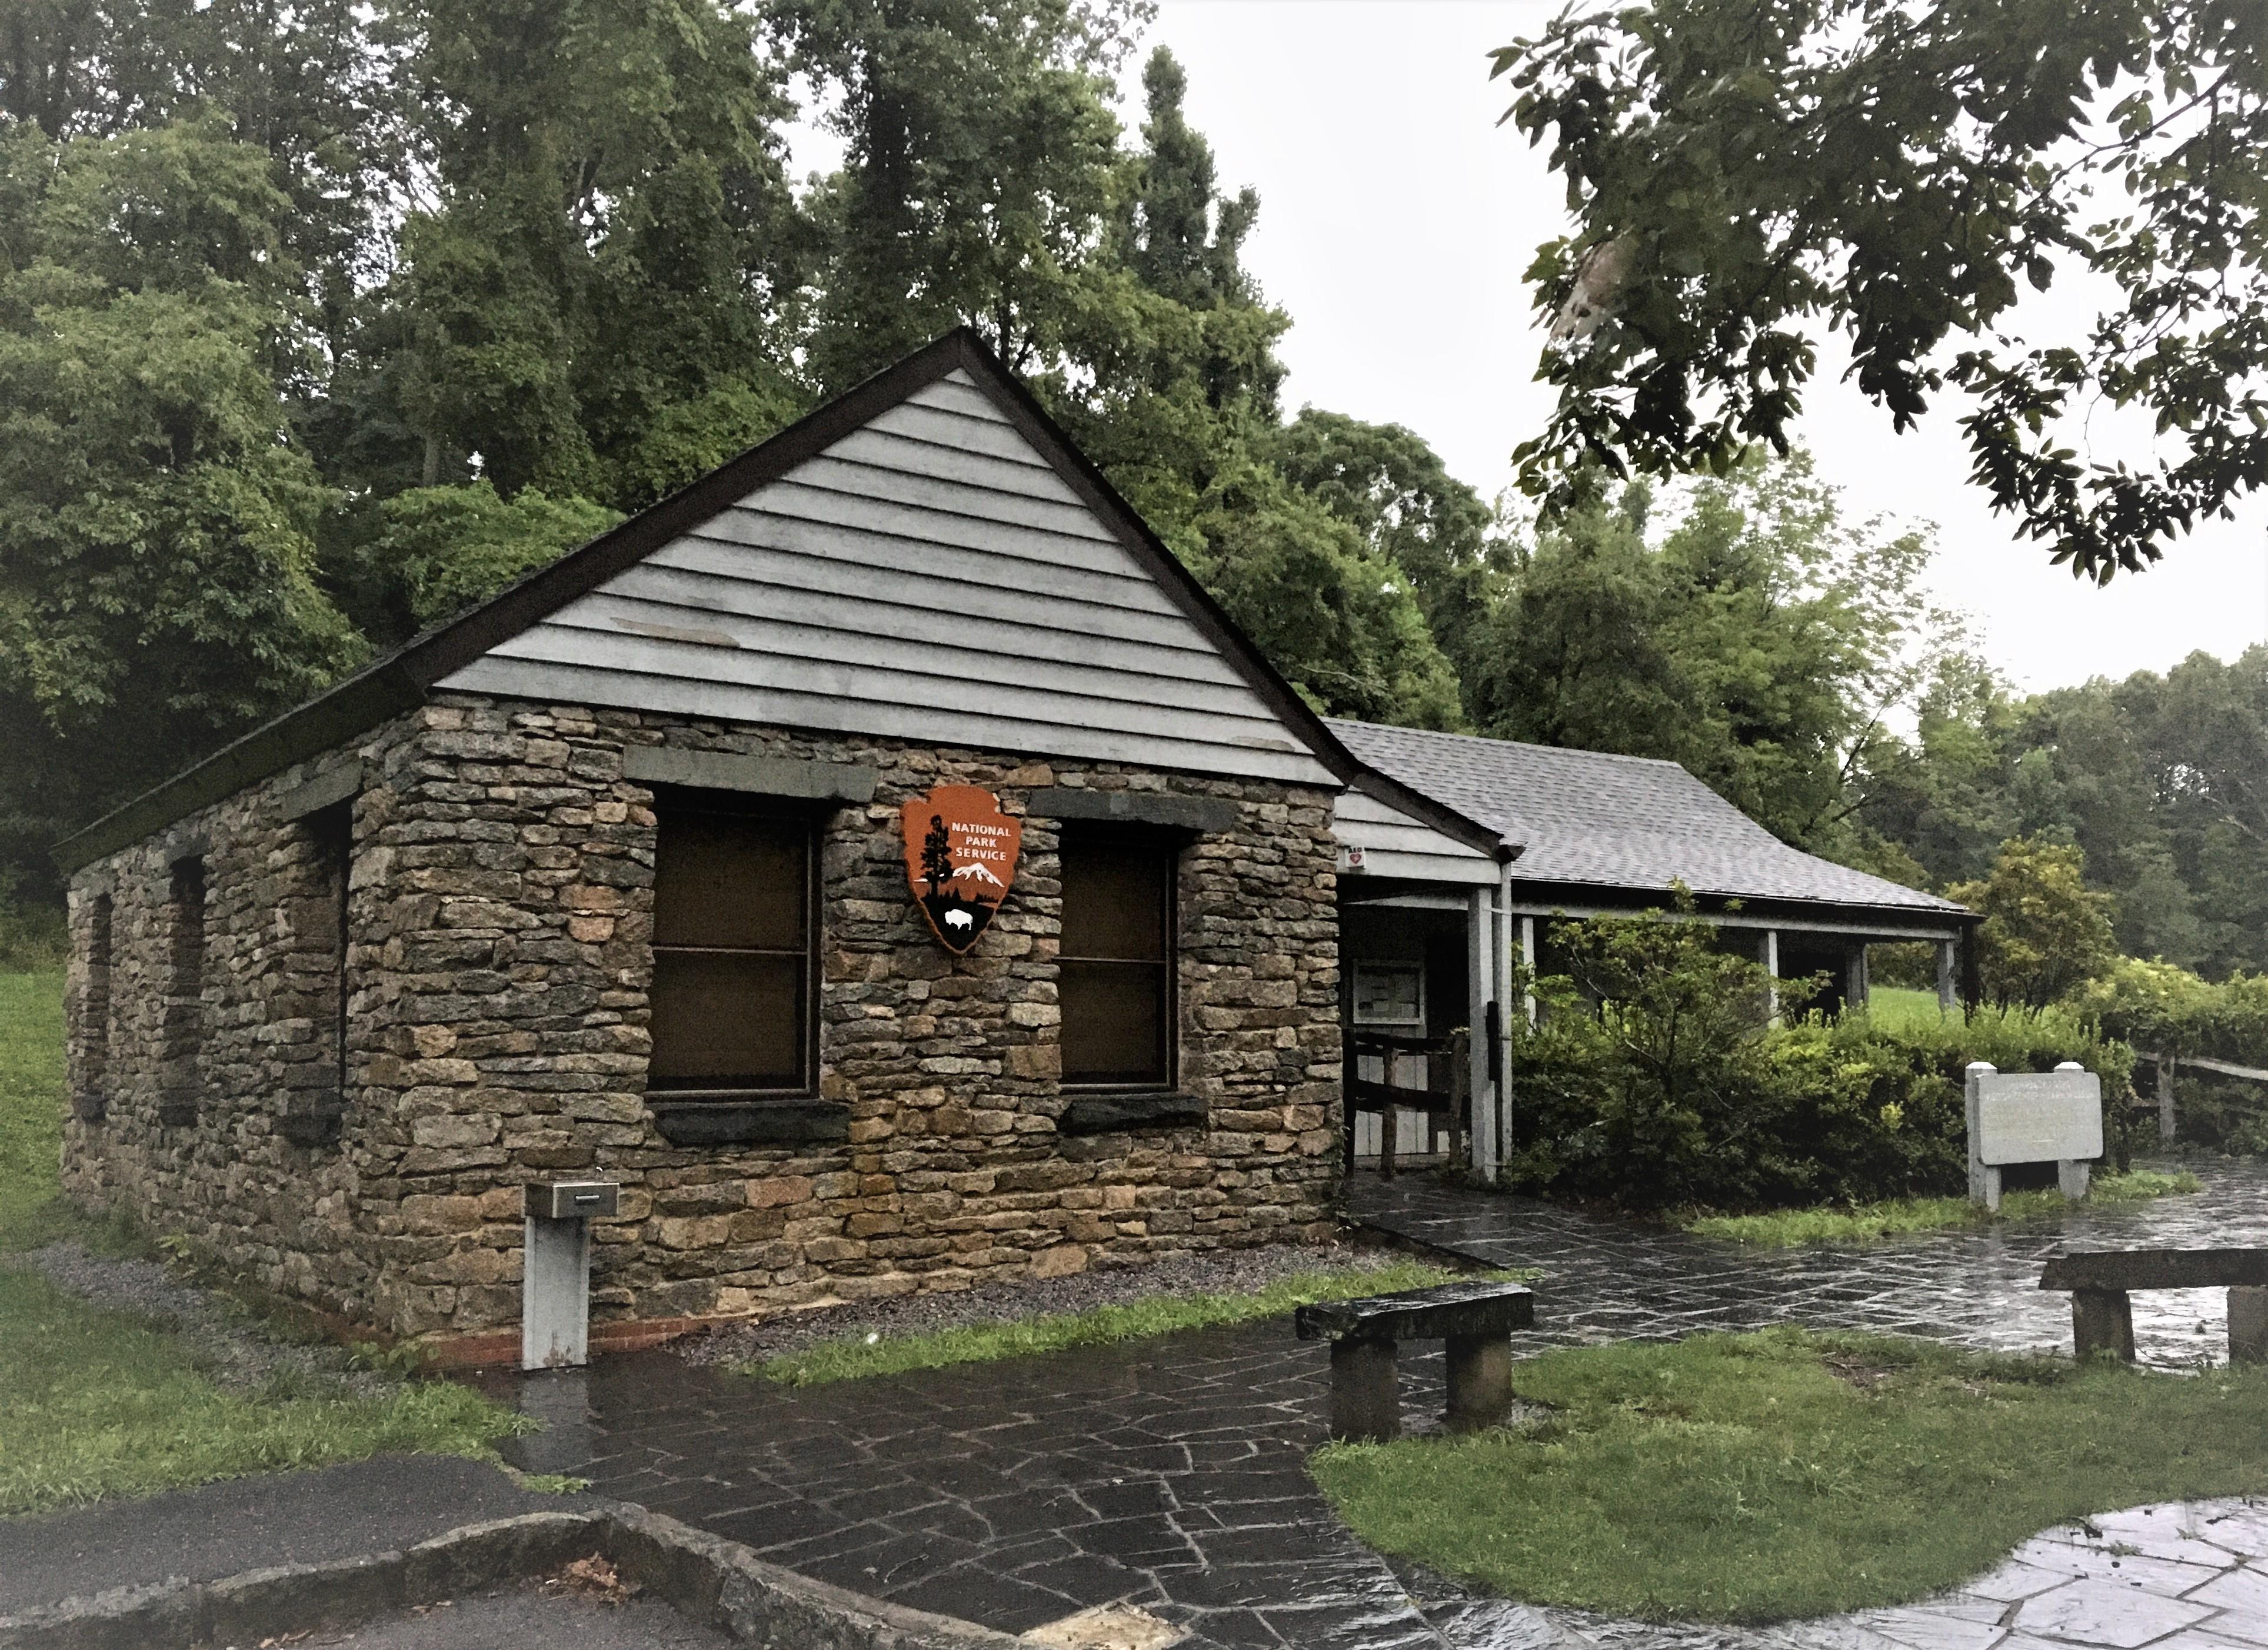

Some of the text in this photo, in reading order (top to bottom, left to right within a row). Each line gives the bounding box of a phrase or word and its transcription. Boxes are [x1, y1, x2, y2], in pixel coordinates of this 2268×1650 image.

[952, 822, 1011, 837] NATIONAL
[966, 836, 997, 847] PARK
[956, 847, 1006, 860] SERVICE
